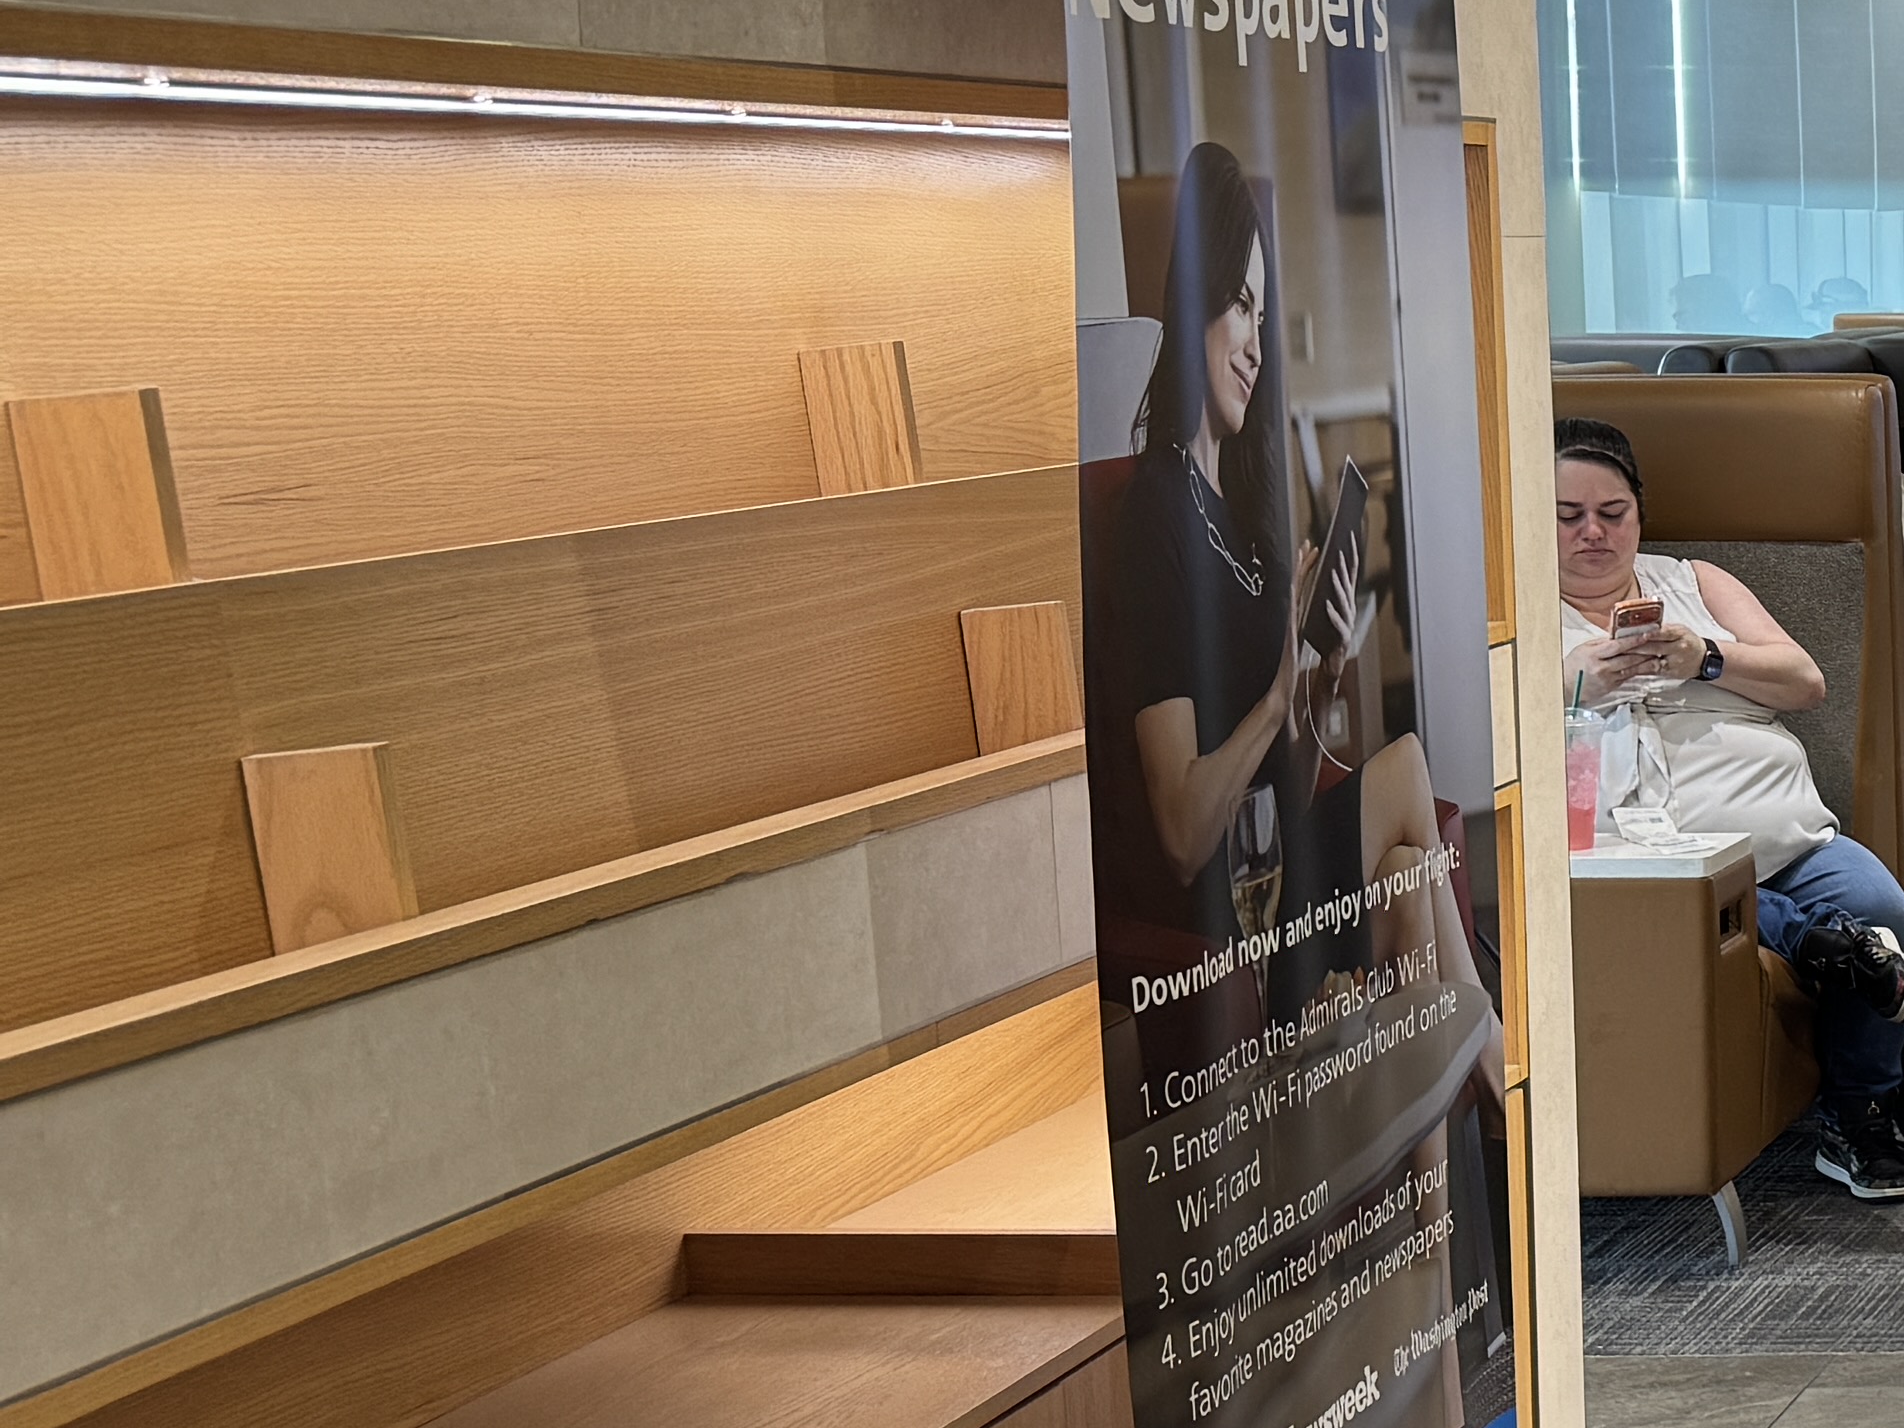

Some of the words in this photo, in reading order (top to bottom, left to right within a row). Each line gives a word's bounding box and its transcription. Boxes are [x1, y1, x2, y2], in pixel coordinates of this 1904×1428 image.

[1131, 936, 1234, 1013] Download
[1238, 926, 1280, 966] now
[1285, 906, 1313, 948] and
[1315, 884, 1362, 934] enjoy
[1364, 880, 1382, 910] on
[1382, 862, 1422, 911] your
[1424, 842, 1461, 886] flight:
[1140, 1082, 1158, 1118] 1.
[1164, 1044, 1238, 1108] Connect
[1240, 1038, 1260, 1069] to
[1263, 1019, 1296, 1056] the
[1300, 978, 1364, 1042] Admirals
[1366, 961, 1395, 1003] Club
[1397, 939, 1438, 986] Wi-Fi
[1145, 1145, 1165, 1184] 2.
[1173, 1120, 1224, 1172] Enter
[1225, 1103, 1249, 1142] the
[1252, 1069, 1302, 1123] Wi-Fi
[1304, 1029, 1373, 1108] password
[1374, 1005, 1415, 1057] found
[1420, 1003, 1439, 1032] on
[1439, 987, 1457, 1021] the
[1156, 1272, 1175, 1310] 3.
[1181, 1257, 1213, 1295] Go
[1217, 1245, 1232, 1277] to
[1234, 1179, 1329, 1263] read.aa.com
[1161, 1334, 1182, 1369] 4.
[1188, 1303, 1235, 1357] Enjoy
[1237, 1239, 1316, 1322] unlimited
[1320, 1188, 1396, 1267] downloads
[1397, 1171, 1412, 1211] of
[1414, 1159, 1449, 1211] your
[1176, 1173, 1228, 1232] Wi-Fi
[1230, 1148, 1261, 1203] card
[1189, 1352, 1253, 1421] favorite
[1256, 1290, 1338, 1370] magazines
[1341, 1259, 1370, 1309] and
[1375, 1210, 1455, 1286] newspapers
